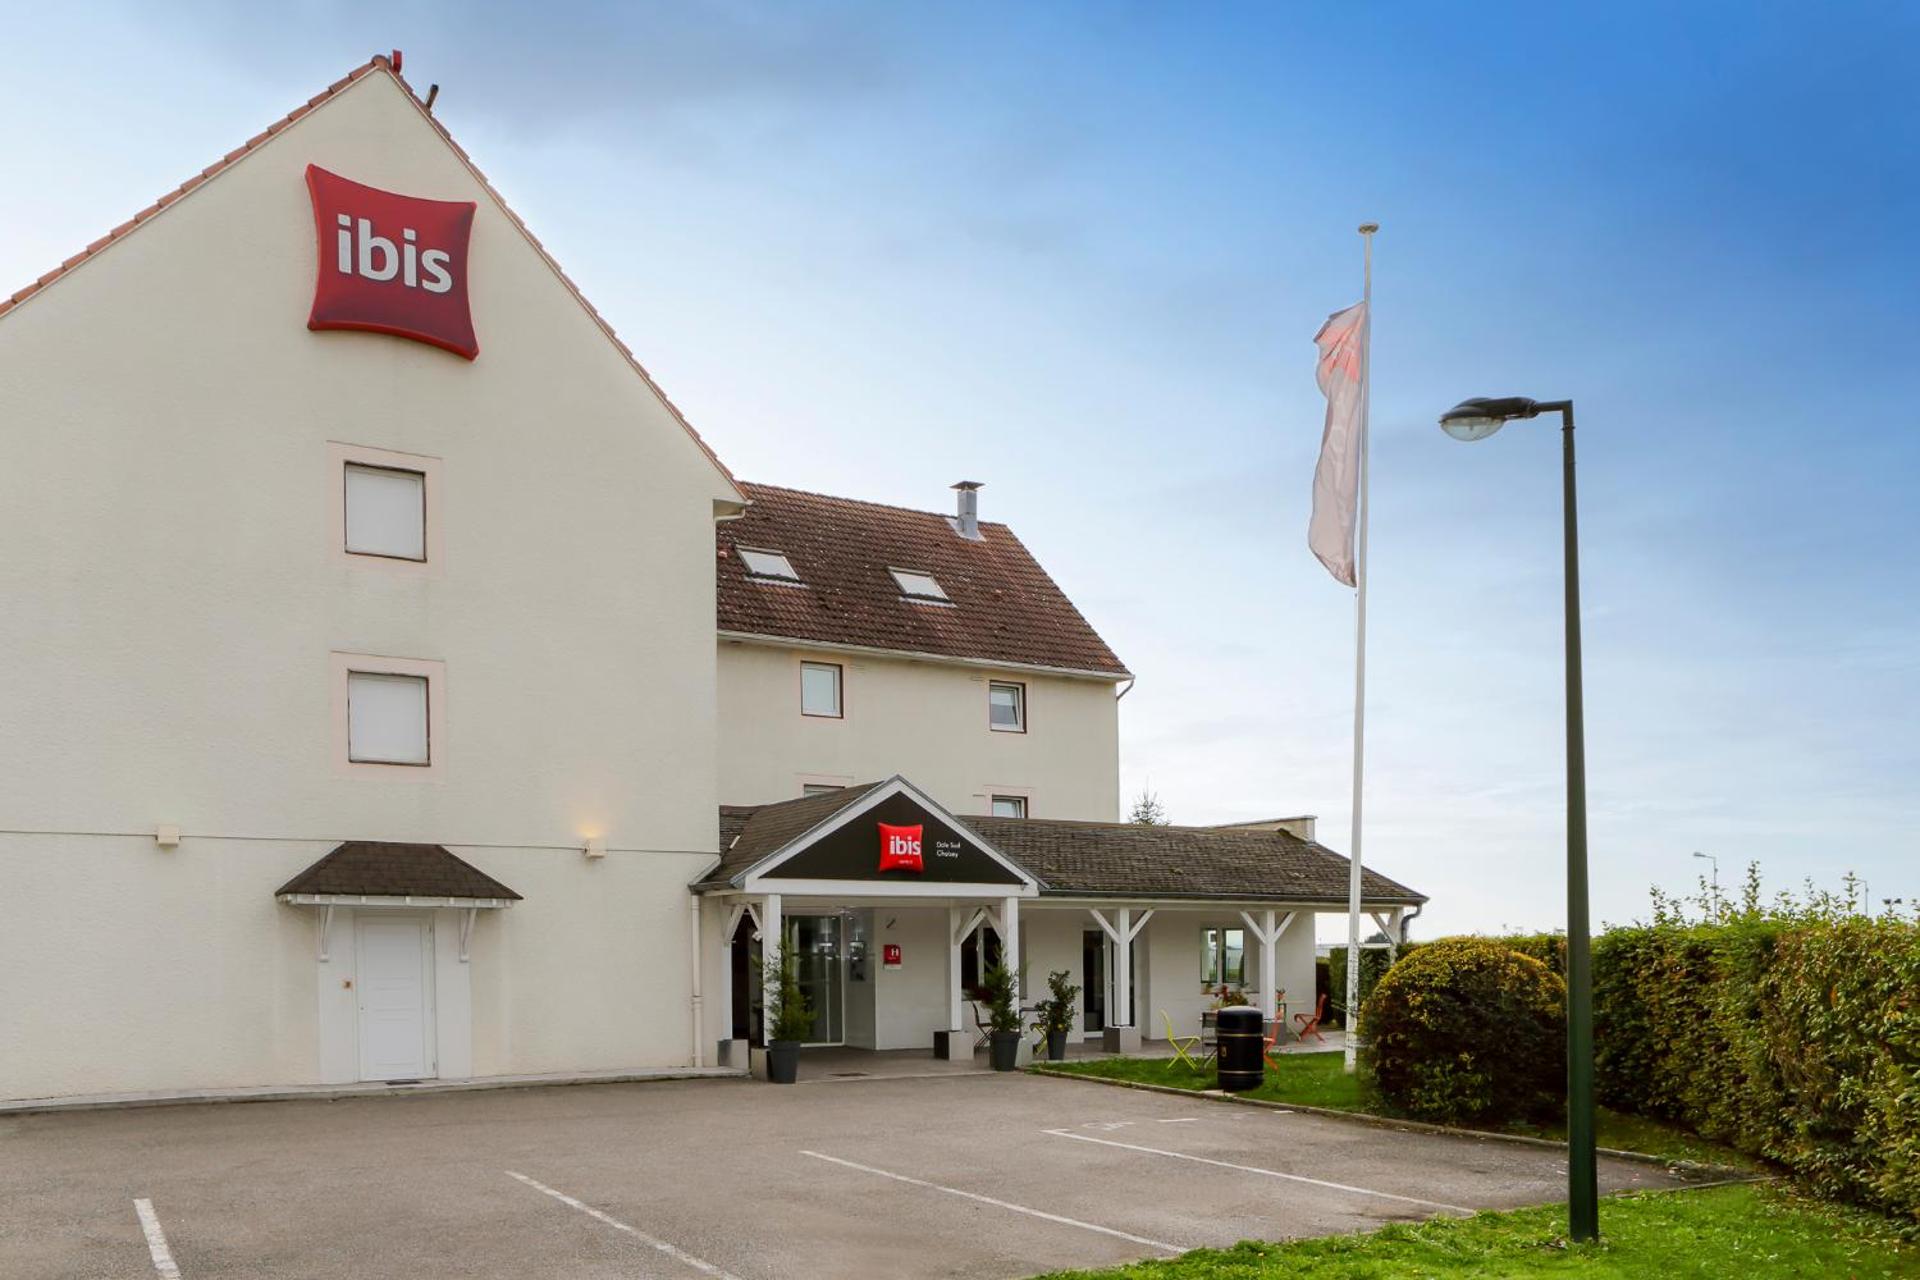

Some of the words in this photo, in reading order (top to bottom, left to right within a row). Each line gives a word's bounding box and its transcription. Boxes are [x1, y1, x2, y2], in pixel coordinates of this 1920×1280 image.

[337, 213, 453, 294] ibis
[889, 836, 921, 855] ibis
[891, 948, 899, 957] H
